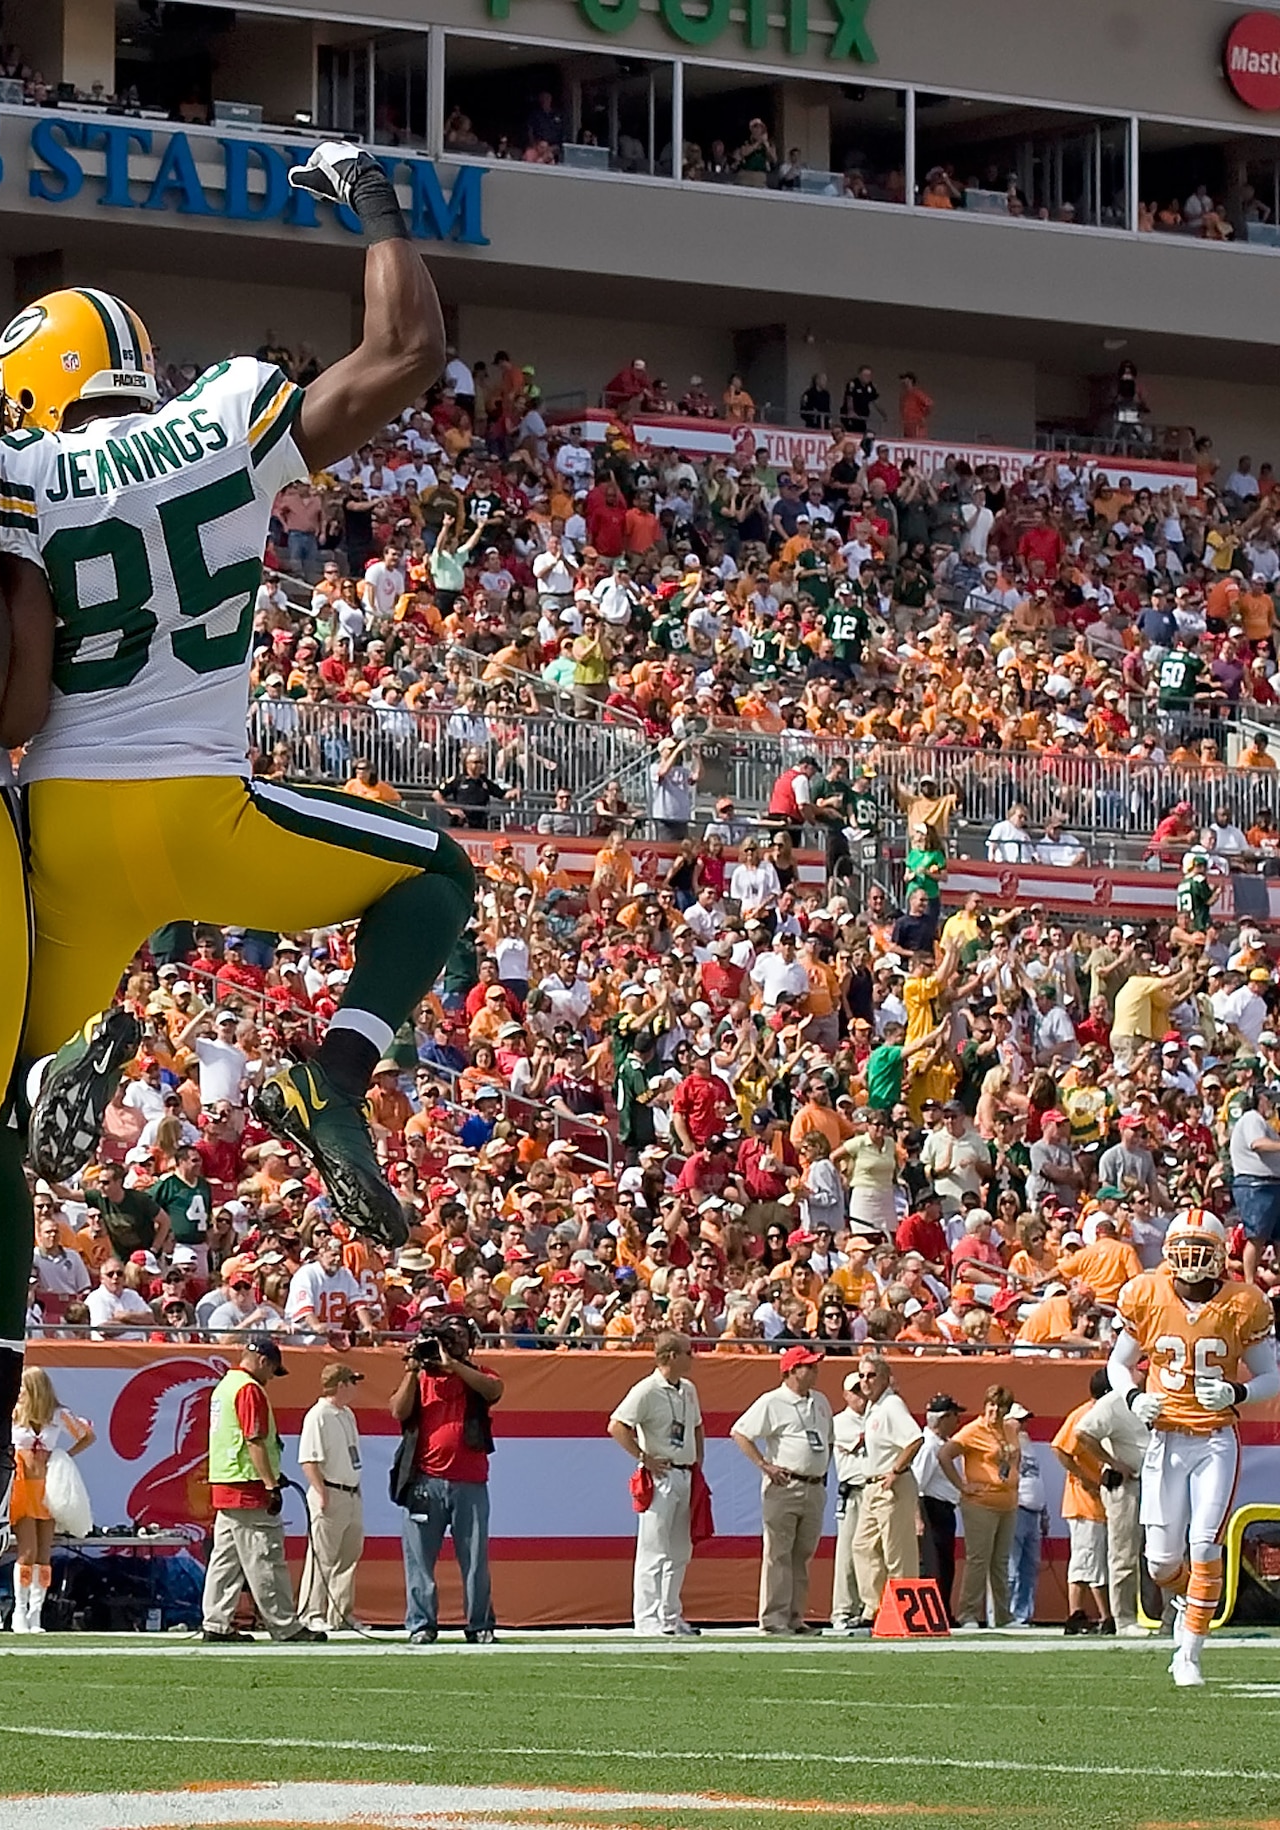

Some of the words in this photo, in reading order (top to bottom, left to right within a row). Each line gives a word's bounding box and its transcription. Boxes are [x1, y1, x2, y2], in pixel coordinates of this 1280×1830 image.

[1231, 45, 1280, 75] Mast
[470, 499, 491, 521] 12
[41, 467, 262, 694] 85
[832, 615, 857, 641] 12
[1162, 661, 1187, 689] 50
[186, 1194, 208, 1232] 4
[319, 1290, 348, 1326] 12
[1153, 1335, 1227, 1390] 36
[896, 1586, 950, 1633] 20
